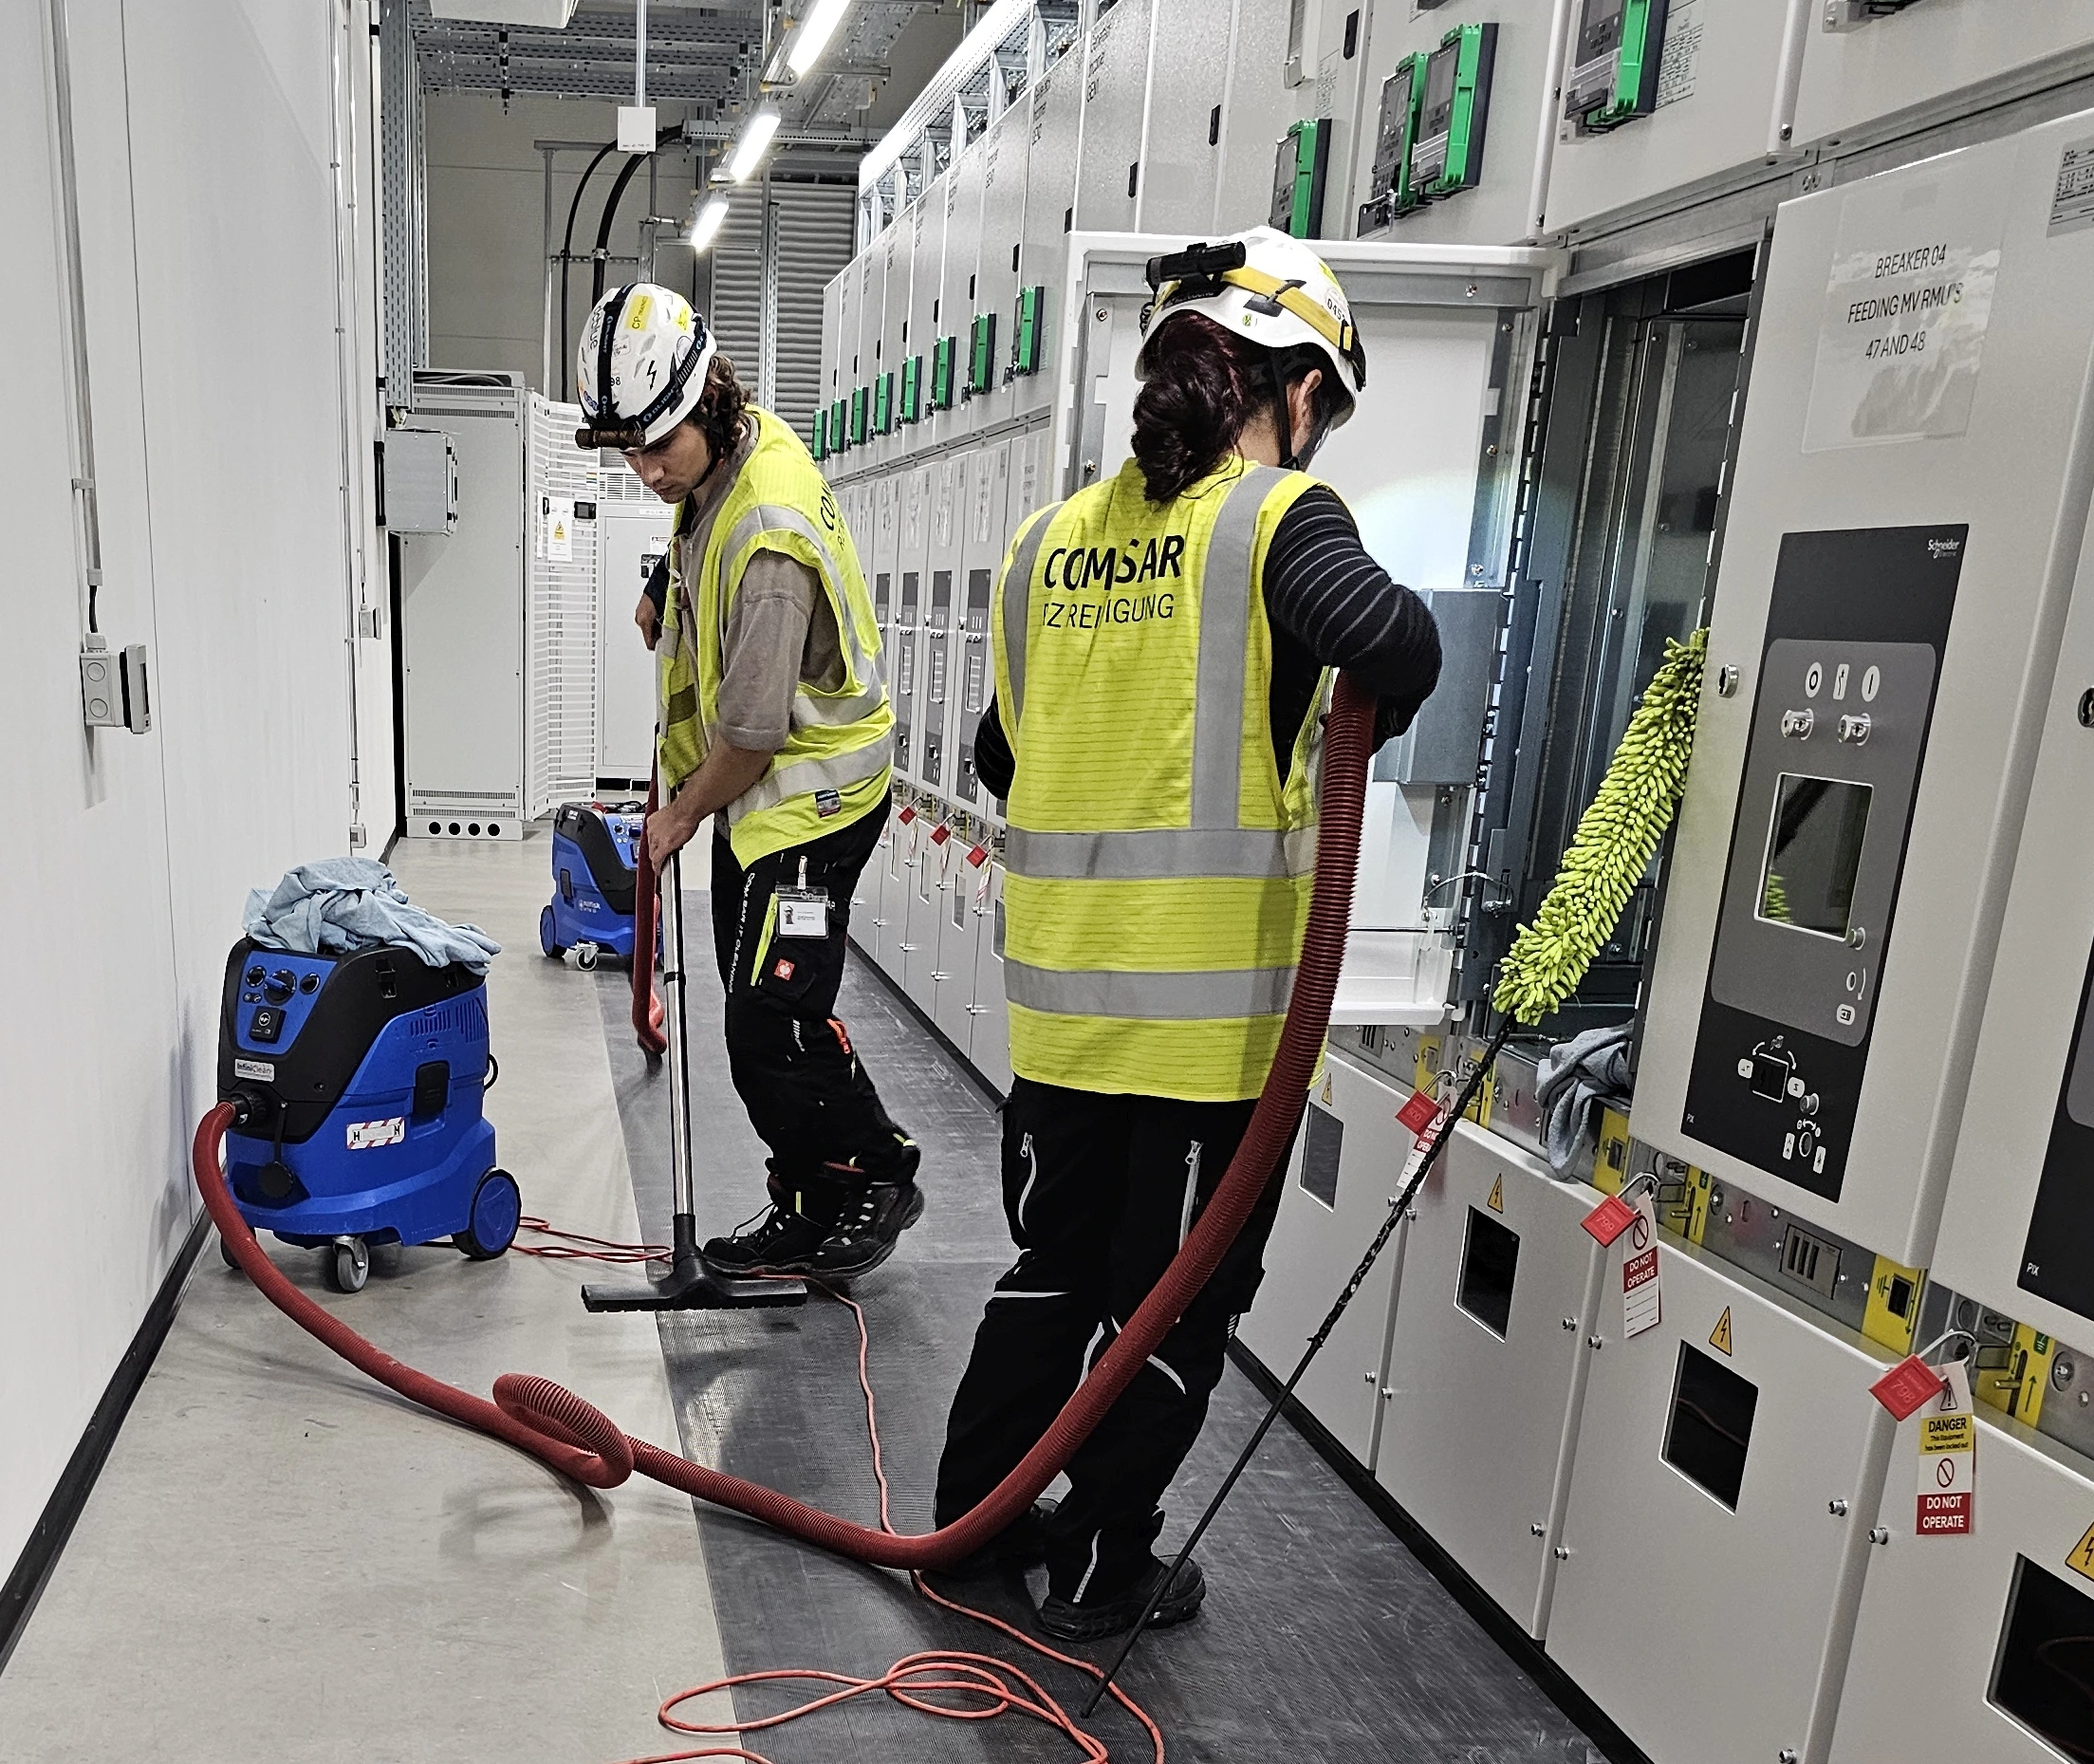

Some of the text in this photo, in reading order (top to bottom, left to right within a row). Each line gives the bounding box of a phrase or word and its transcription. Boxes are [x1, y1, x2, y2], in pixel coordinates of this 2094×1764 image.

[1875, 243, 1947, 278] BREAKER 04
[1847, 295, 1899, 324] FEEDING
[1899, 290, 1920, 314] MV
[1865, 330, 1926, 360] 47 AND 48
[1927, 538, 1960, 551] Schneider
[1044, 534, 1185, 590] COMSAR
[1629, 1251, 1653, 1273] DO NOT
[2026, 1262, 2040, 1277] PIX
[1627, 1265, 1656, 1289] OPERATE
[1928, 1417, 1967, 1433] DANGER
[1927, 1495, 1962, 1510] DO NOT
[1922, 1514, 1964, 1530] OPERATE
